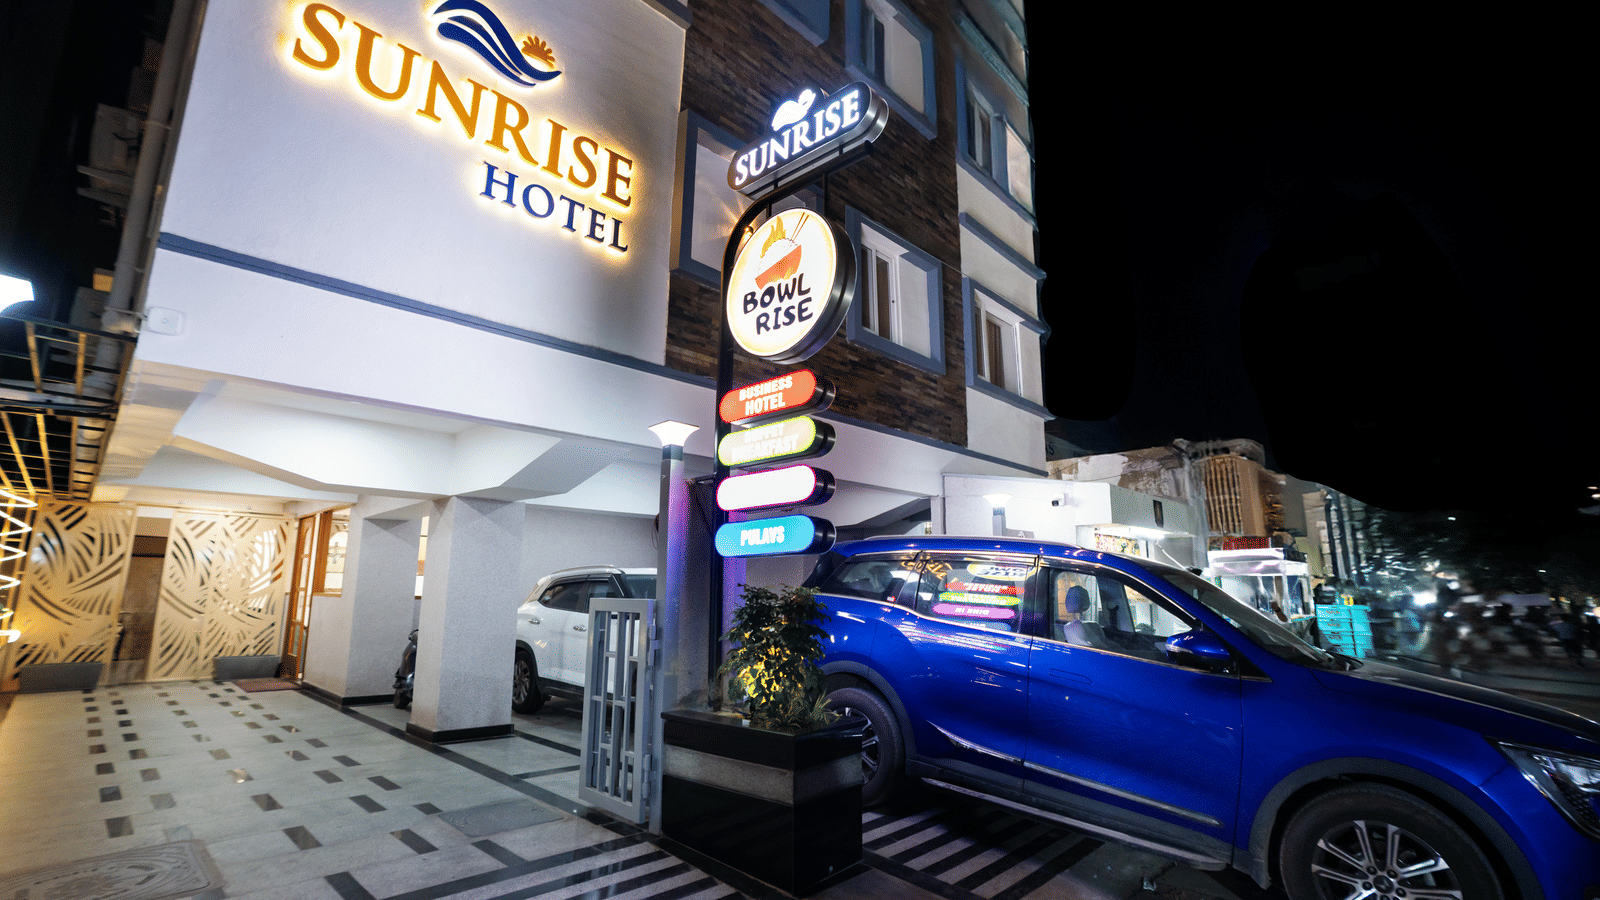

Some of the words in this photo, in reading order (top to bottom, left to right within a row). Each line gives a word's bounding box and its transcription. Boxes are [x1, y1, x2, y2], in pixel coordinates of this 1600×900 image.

[292, 2, 634, 208] SUNRISE
[734, 89, 860, 186] SUNRISE
[479, 161, 629, 253] HOTEL
[743, 273, 811, 314] BOWL
[756, 297, 813, 335] RISE
[739, 375, 793, 401] BUSINESS
[745, 392, 786, 416] HOTEL
